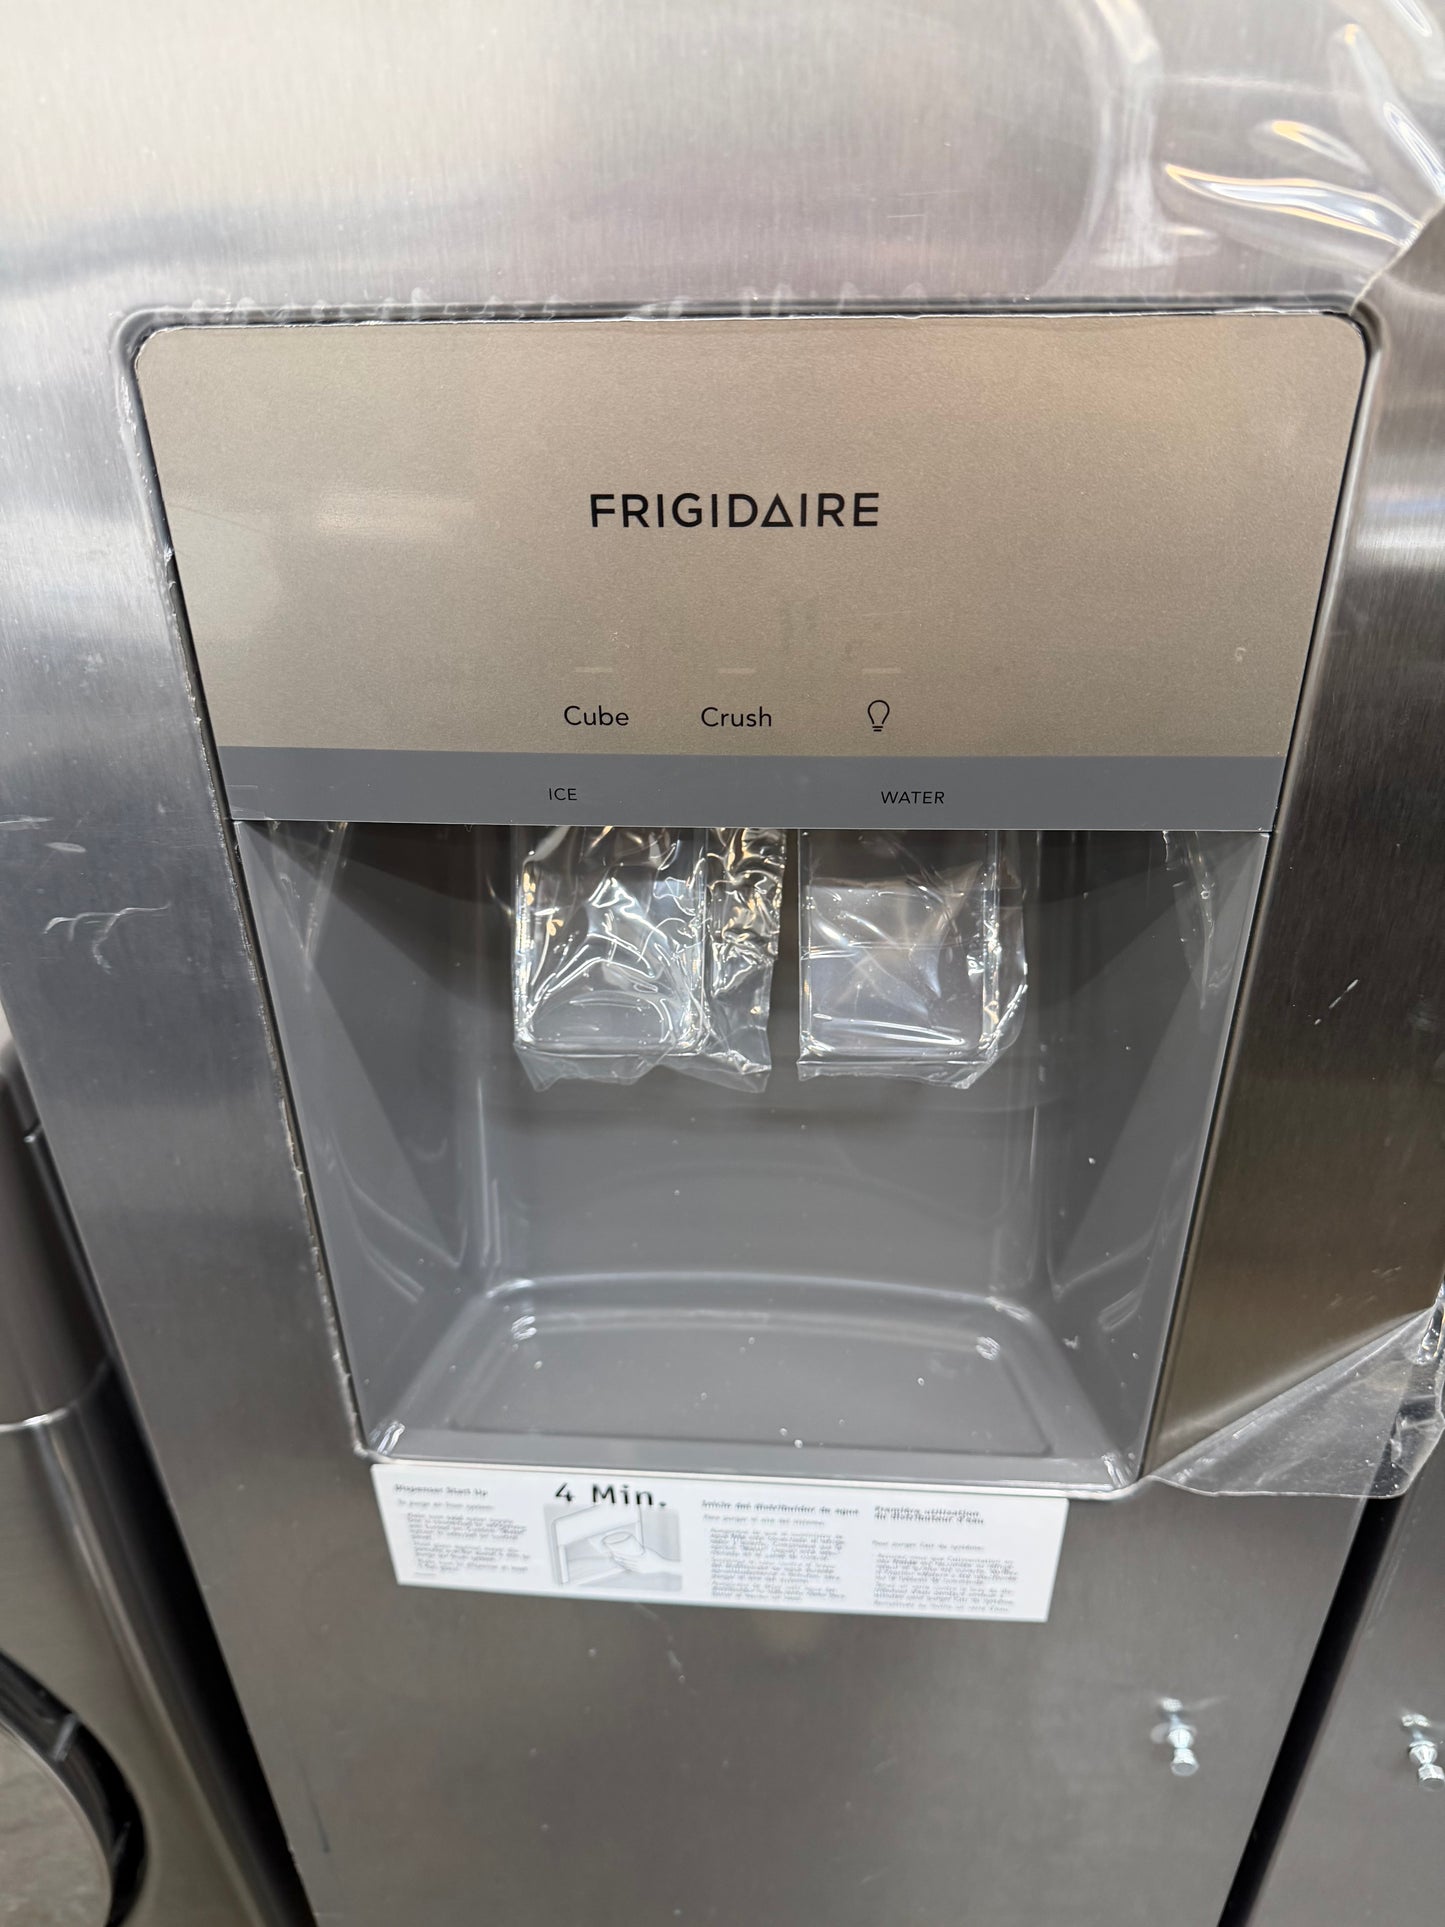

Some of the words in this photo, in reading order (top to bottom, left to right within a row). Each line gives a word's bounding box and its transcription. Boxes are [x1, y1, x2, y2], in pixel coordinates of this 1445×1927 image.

[589, 492, 880, 528] FRIGIDAIRE
[563, 704, 630, 727] Cube
[700, 706, 772, 728] Crush
[548, 787, 578, 801] ICE
[880, 790, 945, 805] WATER
[555, 1482, 575, 1503] 4
[592, 1484, 667, 1506] Min.
